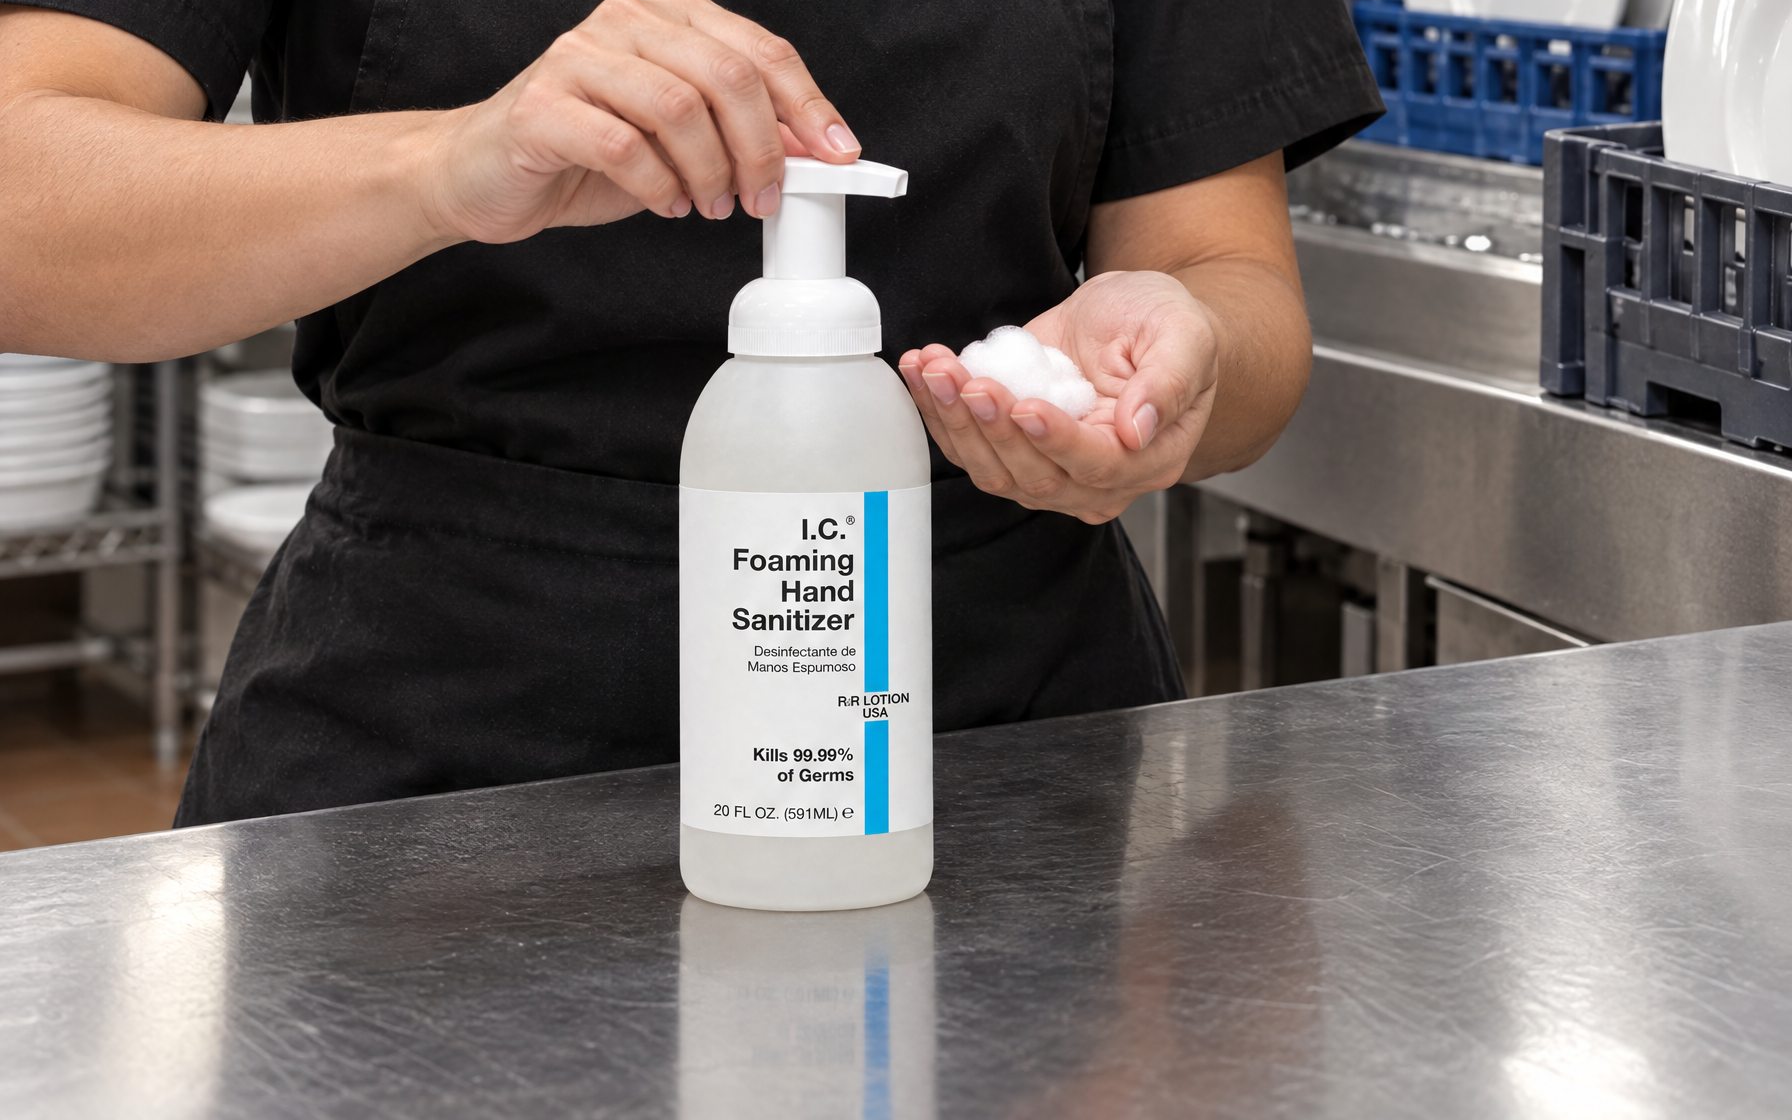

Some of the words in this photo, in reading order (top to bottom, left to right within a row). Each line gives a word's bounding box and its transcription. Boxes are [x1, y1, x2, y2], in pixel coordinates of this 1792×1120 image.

[733, 548, 854, 577] Foaming
[781, 579, 854, 603] Hand
[732, 607, 855, 632] Sanitizer
[754, 645, 838, 658] Desinfectante
[840, 645, 857, 657] de
[747, 660, 789, 673] Manos
[792, 661, 856, 675] Espumoso
[863, 692, 910, 706] LOTION
[862, 706, 889, 719] USA
[753, 747, 789, 763] Kills
[792, 747, 854, 763] 99.99%
[777, 768, 795, 783] of
[798, 768, 855, 783] Germs
[713, 803, 730, 817] 20
[734, 805, 752, 819] FL
[754, 806, 779, 820] OZ.
[784, 807, 838, 822] (591ML)
